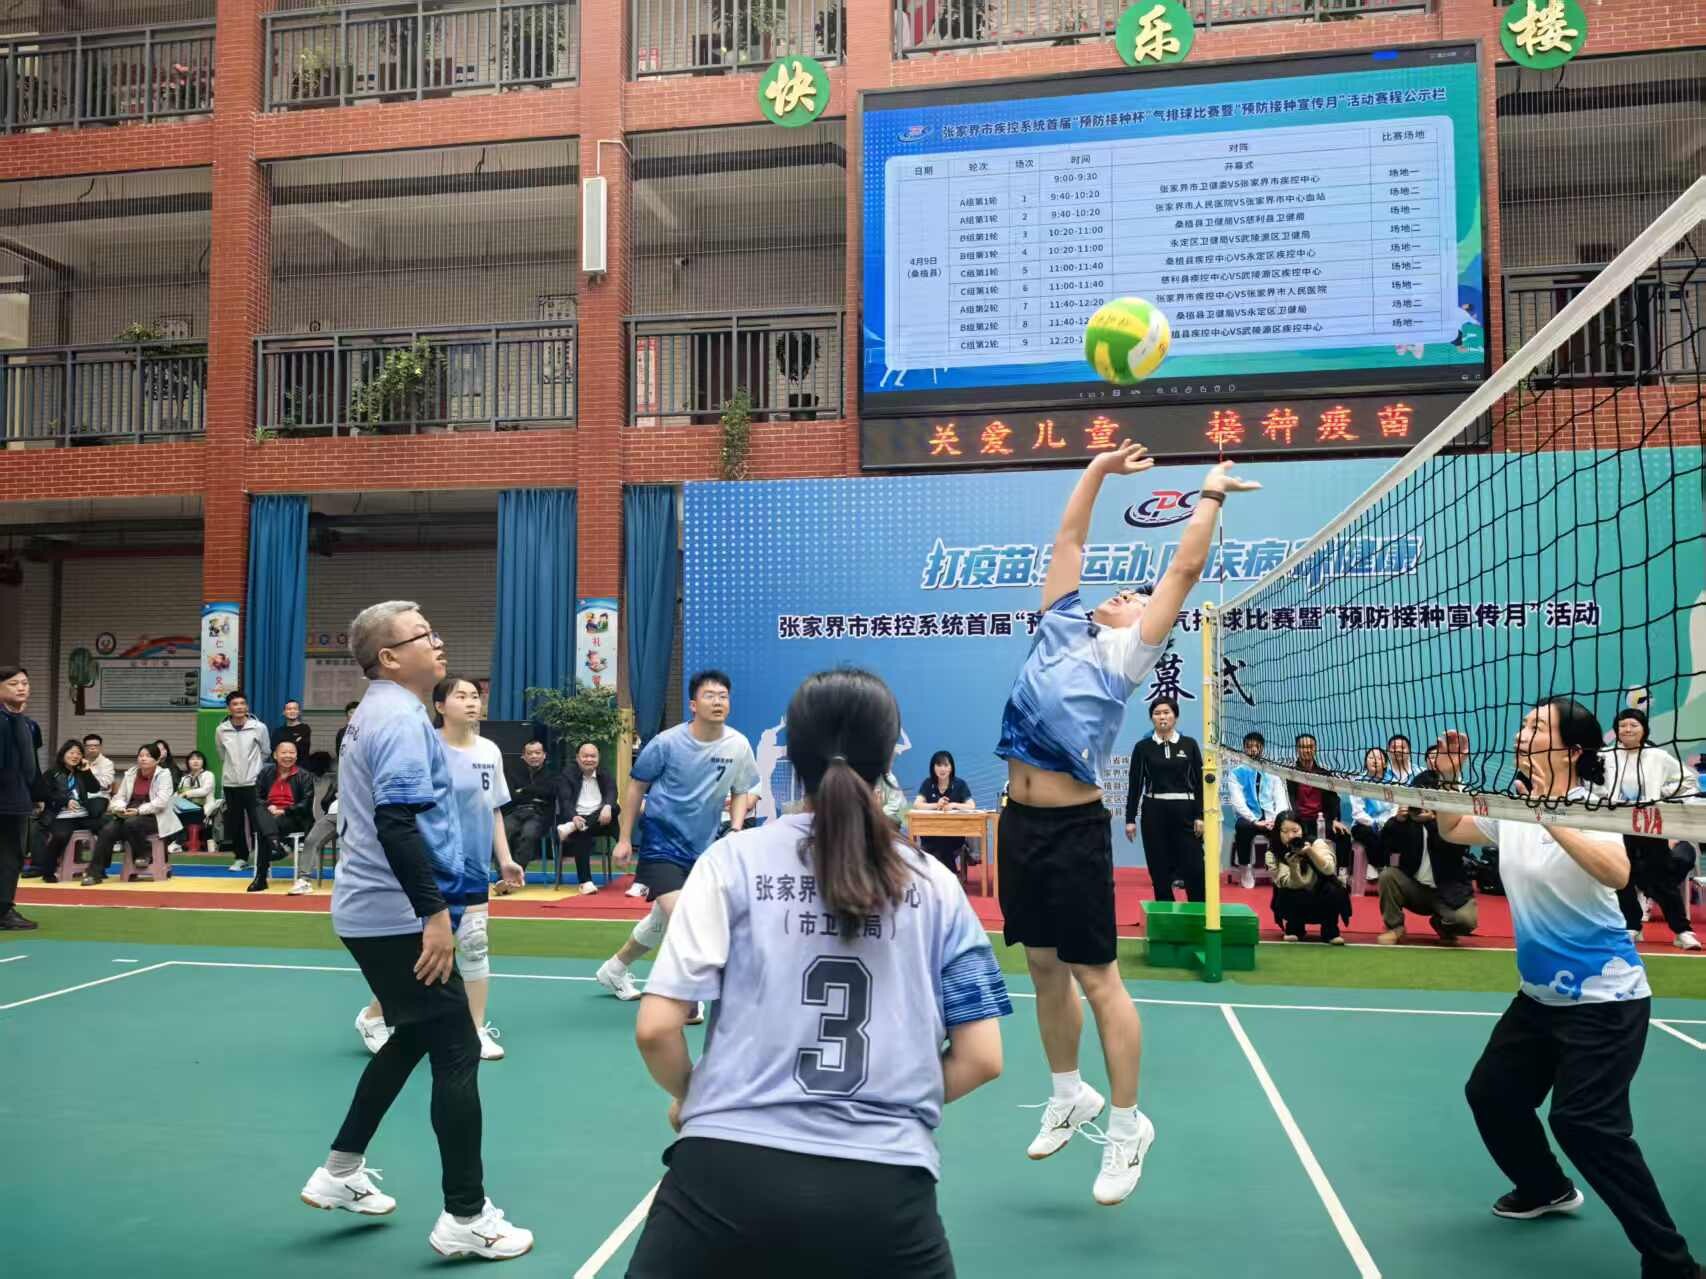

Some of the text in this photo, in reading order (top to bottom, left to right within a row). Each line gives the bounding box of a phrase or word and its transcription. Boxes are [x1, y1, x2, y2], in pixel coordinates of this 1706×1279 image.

[764, 0, 1578, 117] 快 乐 楼
[1382, 130, 1425, 142] 比赛场地
[1015, 159, 1034, 169] 场次
[1070, 154, 1091, 165] 时间
[968, 162, 989, 172] 轮次
[1224, 160, 1254, 171] 开幕式
[914, 166, 934, 176] 日期
[1389, 168, 1419, 177] 场地一
[1054, 172, 1098, 183] 9:00-9:30
[1050, 190, 1100, 201] 9:40-10:20
[1390, 186, 1420, 196] 场地二
[960, 197, 999, 207] A组第1轮
[1022, 195, 1027, 203] 1
[1051, 208, 1101, 219] 9:40-10:20
[1390, 205, 1420, 214] 场地一
[960, 215, 999, 225] A组第1轮
[1022, 213, 1028, 221] 2
[1049, 226, 1104, 237] 10:20-11:00
[1390, 223, 1420, 233] 场地二
[960, 232, 999, 242] B组第1轮
[1022, 231, 1028, 239] 3
[1049, 244, 1104, 255] 10:20-11:00
[1391, 242, 1421, 252] 场地一
[960, 250, 999, 260] B组第1轮
[1022, 249, 1028, 257] 4
[910, 256, 937, 266] 4月9日
[1391, 261, 1422, 271] 场地二
[1022, 267, 1028, 275] 5
[1050, 262, 1104, 273] 11:00-11:40
[960, 268, 999, 278] C组第1轮
[1022, 285, 1028, 293] 6
[1050, 280, 1104, 291] 11:00-11:40
[1392, 279, 1422, 289] 场地一
[960, 286, 999, 296] C组第1轮
[1022, 303, 1028, 311] 7
[1050, 298, 1104, 309] 11:40-12:20
[1392, 298, 1422, 308] 场地二
[960, 304, 999, 314] A组第2轮
[960, 322, 999, 332] B组第2轮
[1022, 321, 1028, 329] 8
[1050, 317, 1089, 327] 11:40-12
[1392, 317, 1424, 327] 场地一
[1171, 322, 1323, 339] 植县疾控中心VS武陵源区疾控中心
[960, 340, 999, 350] C组第2轮
[1022, 339, 1028, 347] 9
[1050, 336, 1083, 345] 12:20-1
[928, 403, 1415, 456] 关爱儿童 接种疫苗
[716, 765, 726, 782] 7
[481, 771, 490, 791] 6
[755, 874, 922, 910] 张家界心
[783, 909, 897, 940] （市卫局）
[793, 955, 873, 1097] 3
